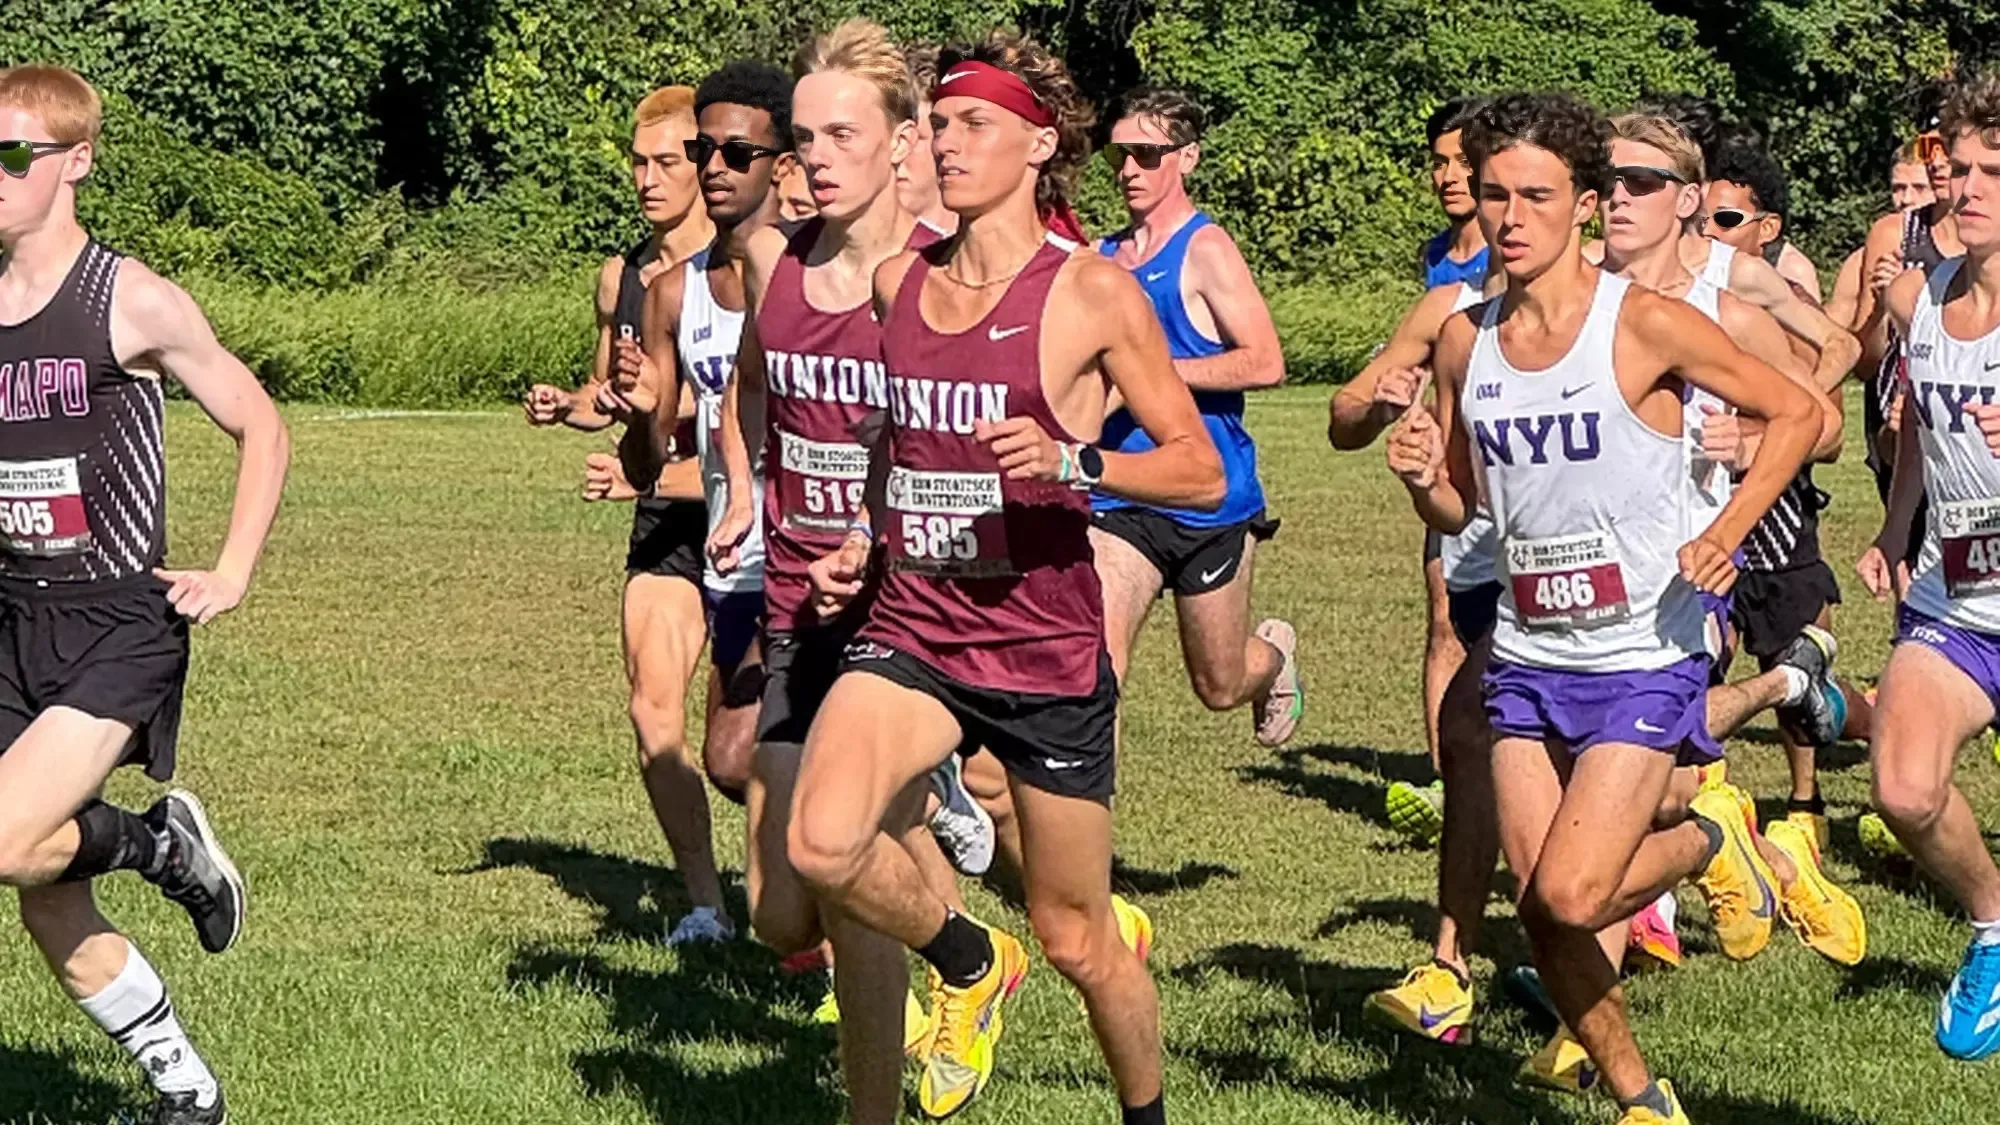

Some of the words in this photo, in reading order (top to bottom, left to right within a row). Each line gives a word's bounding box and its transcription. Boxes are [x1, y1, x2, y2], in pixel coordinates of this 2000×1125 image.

[765, 350, 889, 409] UNION
[888, 376, 1009, 435] UNION
[1908, 380, 1996, 434] NY
[1473, 411, 1601, 467] NYU
[0, 500, 54, 536] 505
[803, 479, 866, 513] 519
[902, 514, 979, 560] 585
[1535, 572, 1596, 610] 486
